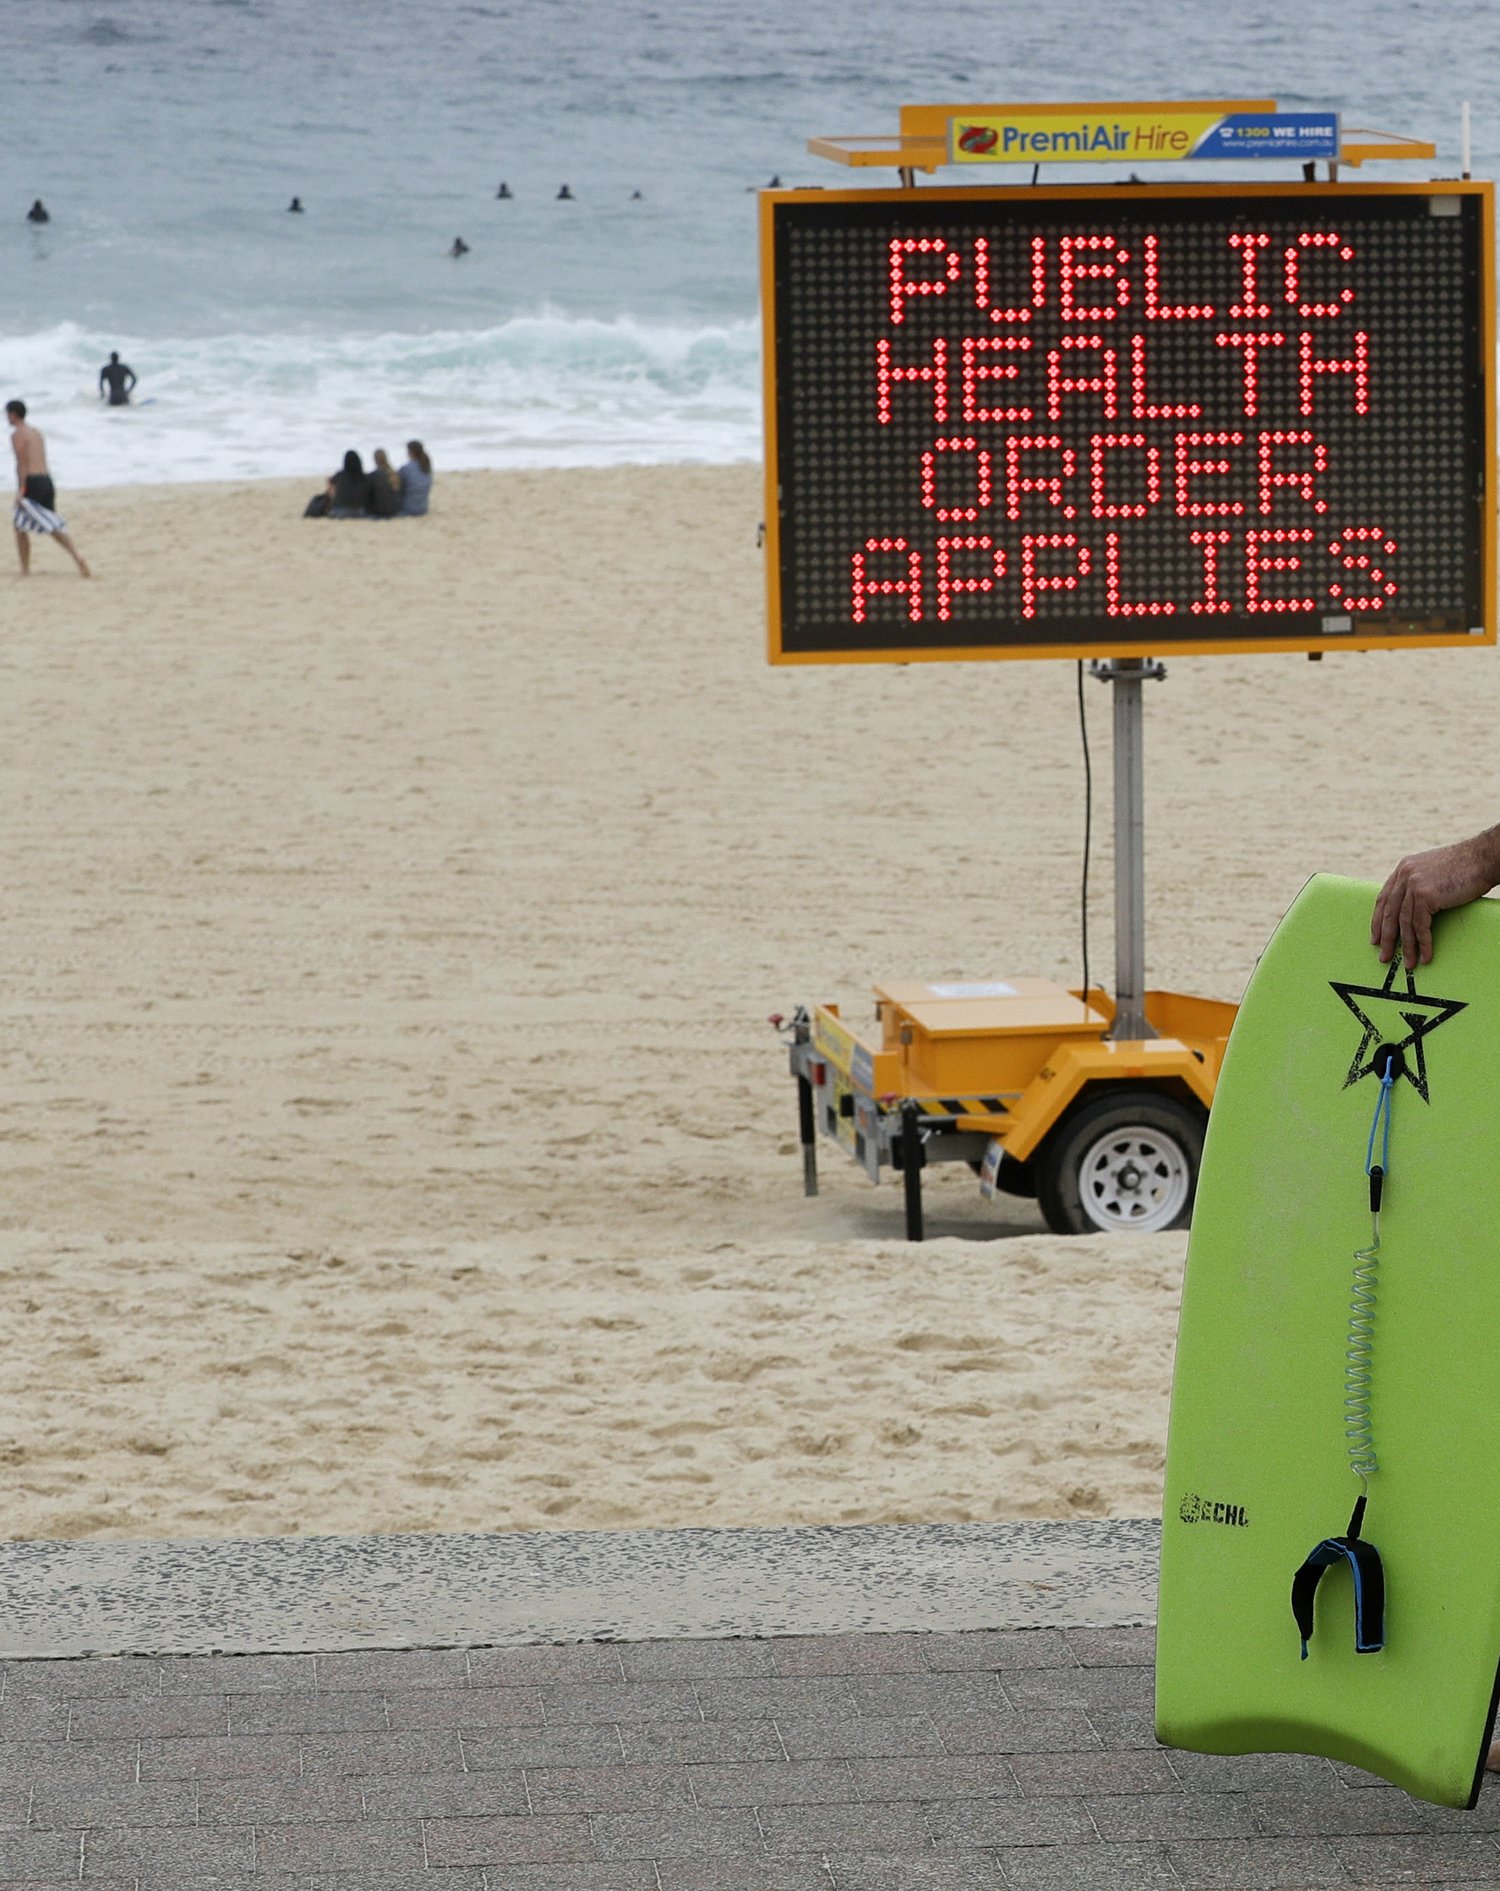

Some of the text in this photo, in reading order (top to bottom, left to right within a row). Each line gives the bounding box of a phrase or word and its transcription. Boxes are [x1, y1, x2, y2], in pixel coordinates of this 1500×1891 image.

[1003, 124, 1189, 152] PremiAir Hire
[1237, 127, 1333, 138] 1300 WE HIRE
[890, 233, 1354, 324] PUBLIC
[877, 332, 1368, 423] HEALTH
[921, 431, 1327, 522] ORDER
[852, 528, 1397, 622] APPLIES
